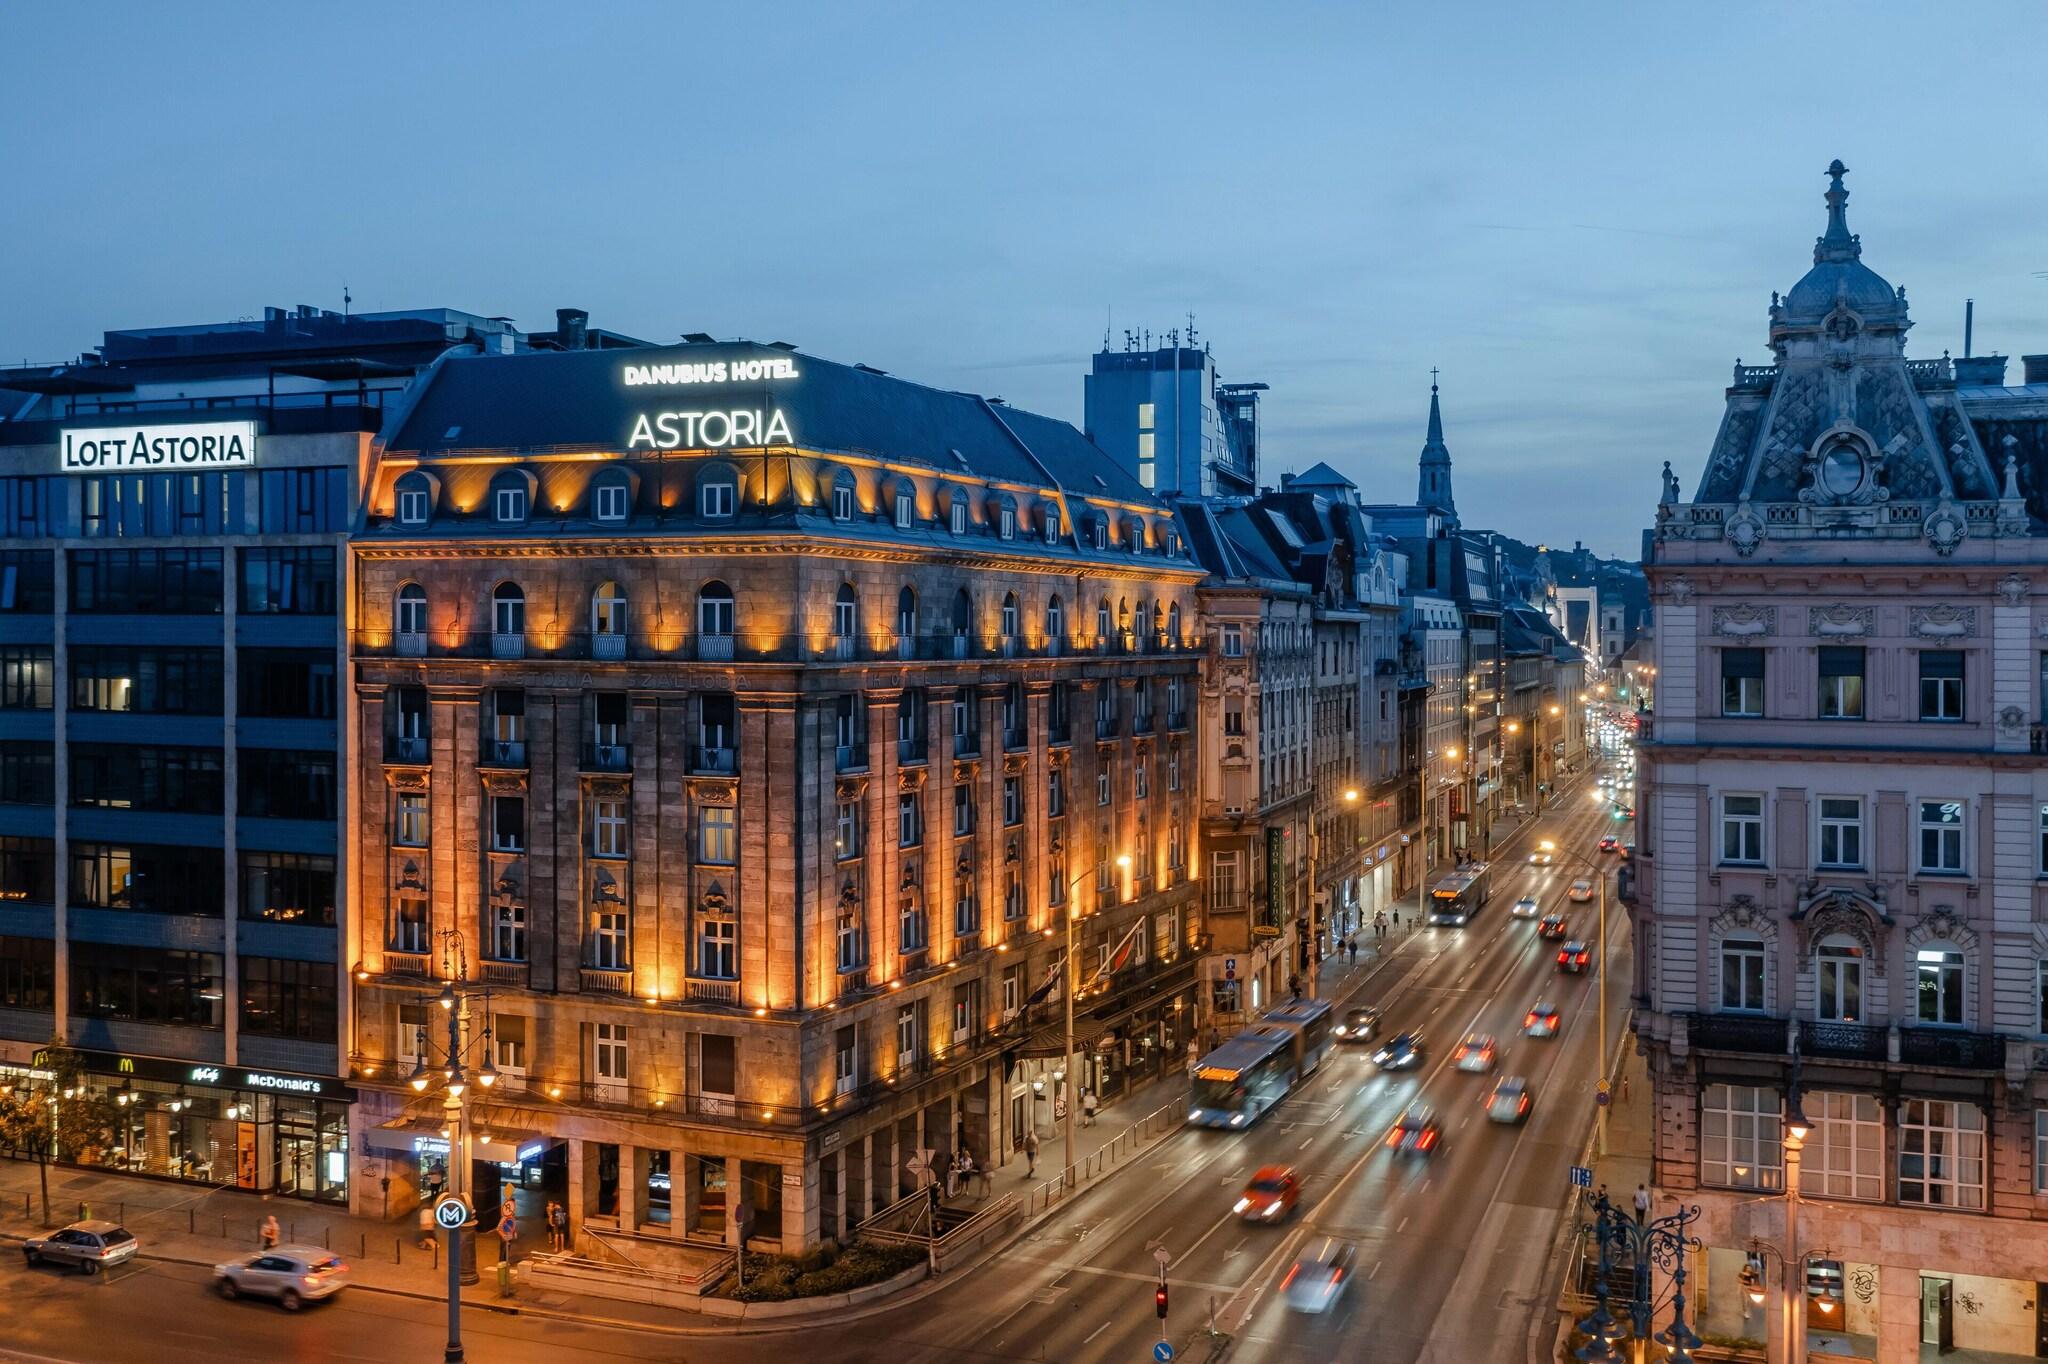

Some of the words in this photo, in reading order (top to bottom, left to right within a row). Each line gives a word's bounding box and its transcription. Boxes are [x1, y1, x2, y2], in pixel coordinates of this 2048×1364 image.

[624, 362, 727, 386] DANUBIUS
[731, 358, 799, 381] HOTEL
[628, 408, 794, 449] ASTORIA
[66, 434, 127, 467] LOFT
[129, 431, 246, 465] ASTORIA
[401, 669, 465, 683] HOTEL
[247, 1073, 321, 1093] McDonald's
[442, 1206, 460, 1223] M
